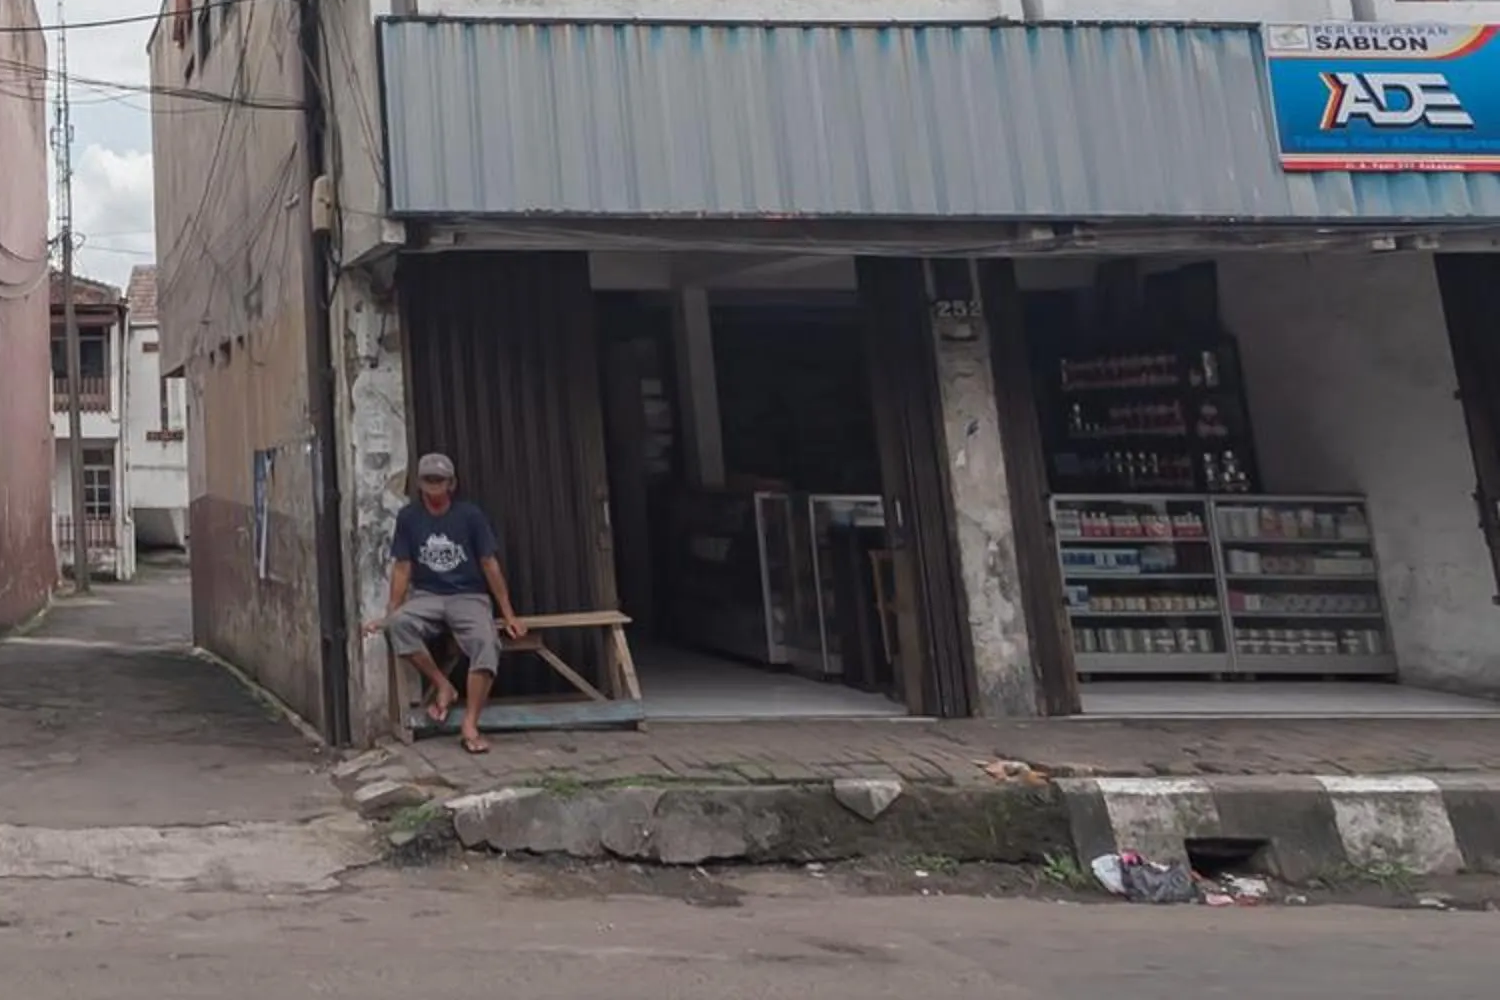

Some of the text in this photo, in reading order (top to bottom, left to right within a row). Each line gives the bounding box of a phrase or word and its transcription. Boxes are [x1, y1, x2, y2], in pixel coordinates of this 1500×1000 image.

[1314, 25, 1449, 37] PERLENGKAPAN
[1316, 35, 1428, 51] SABLON
[1319, 72, 1475, 129] ADE
